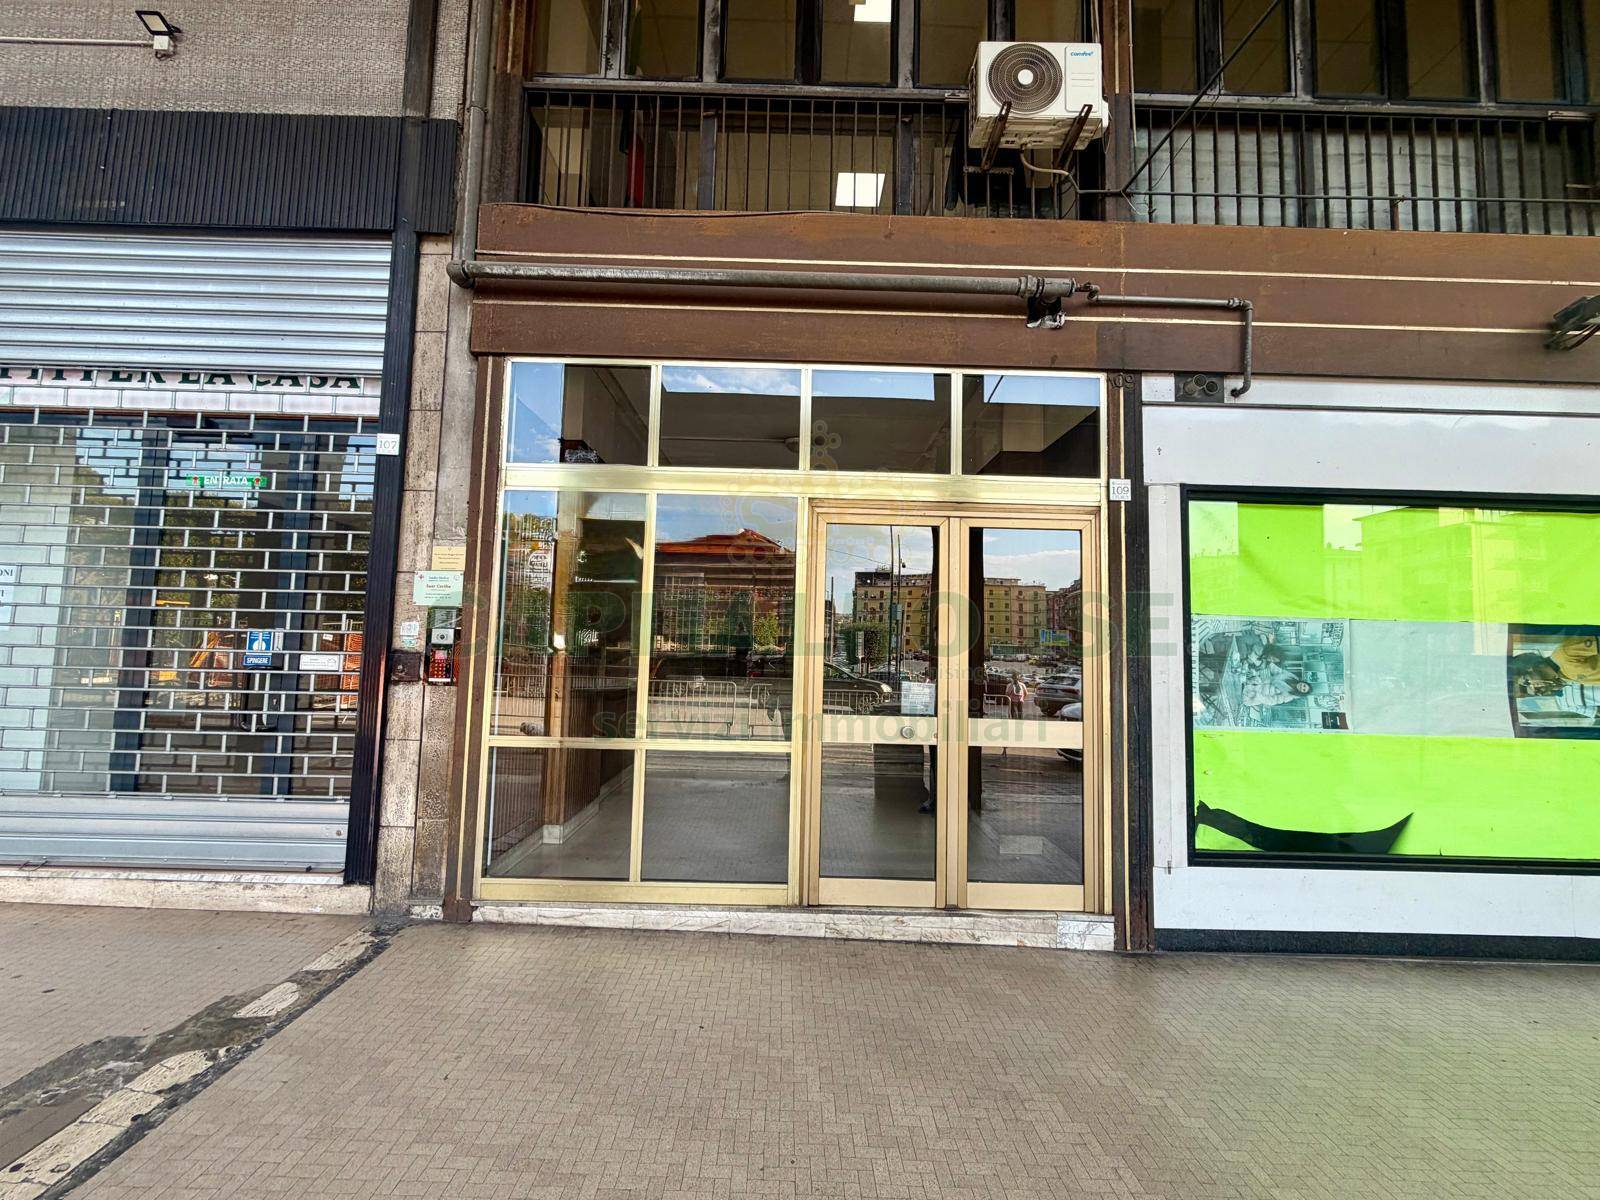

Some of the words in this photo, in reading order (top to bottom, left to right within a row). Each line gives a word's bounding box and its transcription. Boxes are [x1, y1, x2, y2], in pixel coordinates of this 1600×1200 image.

[379, 440, 397, 449] 107
[1112, 486, 1129, 495] 109
[246, 657, 269, 665] SPINGERE
